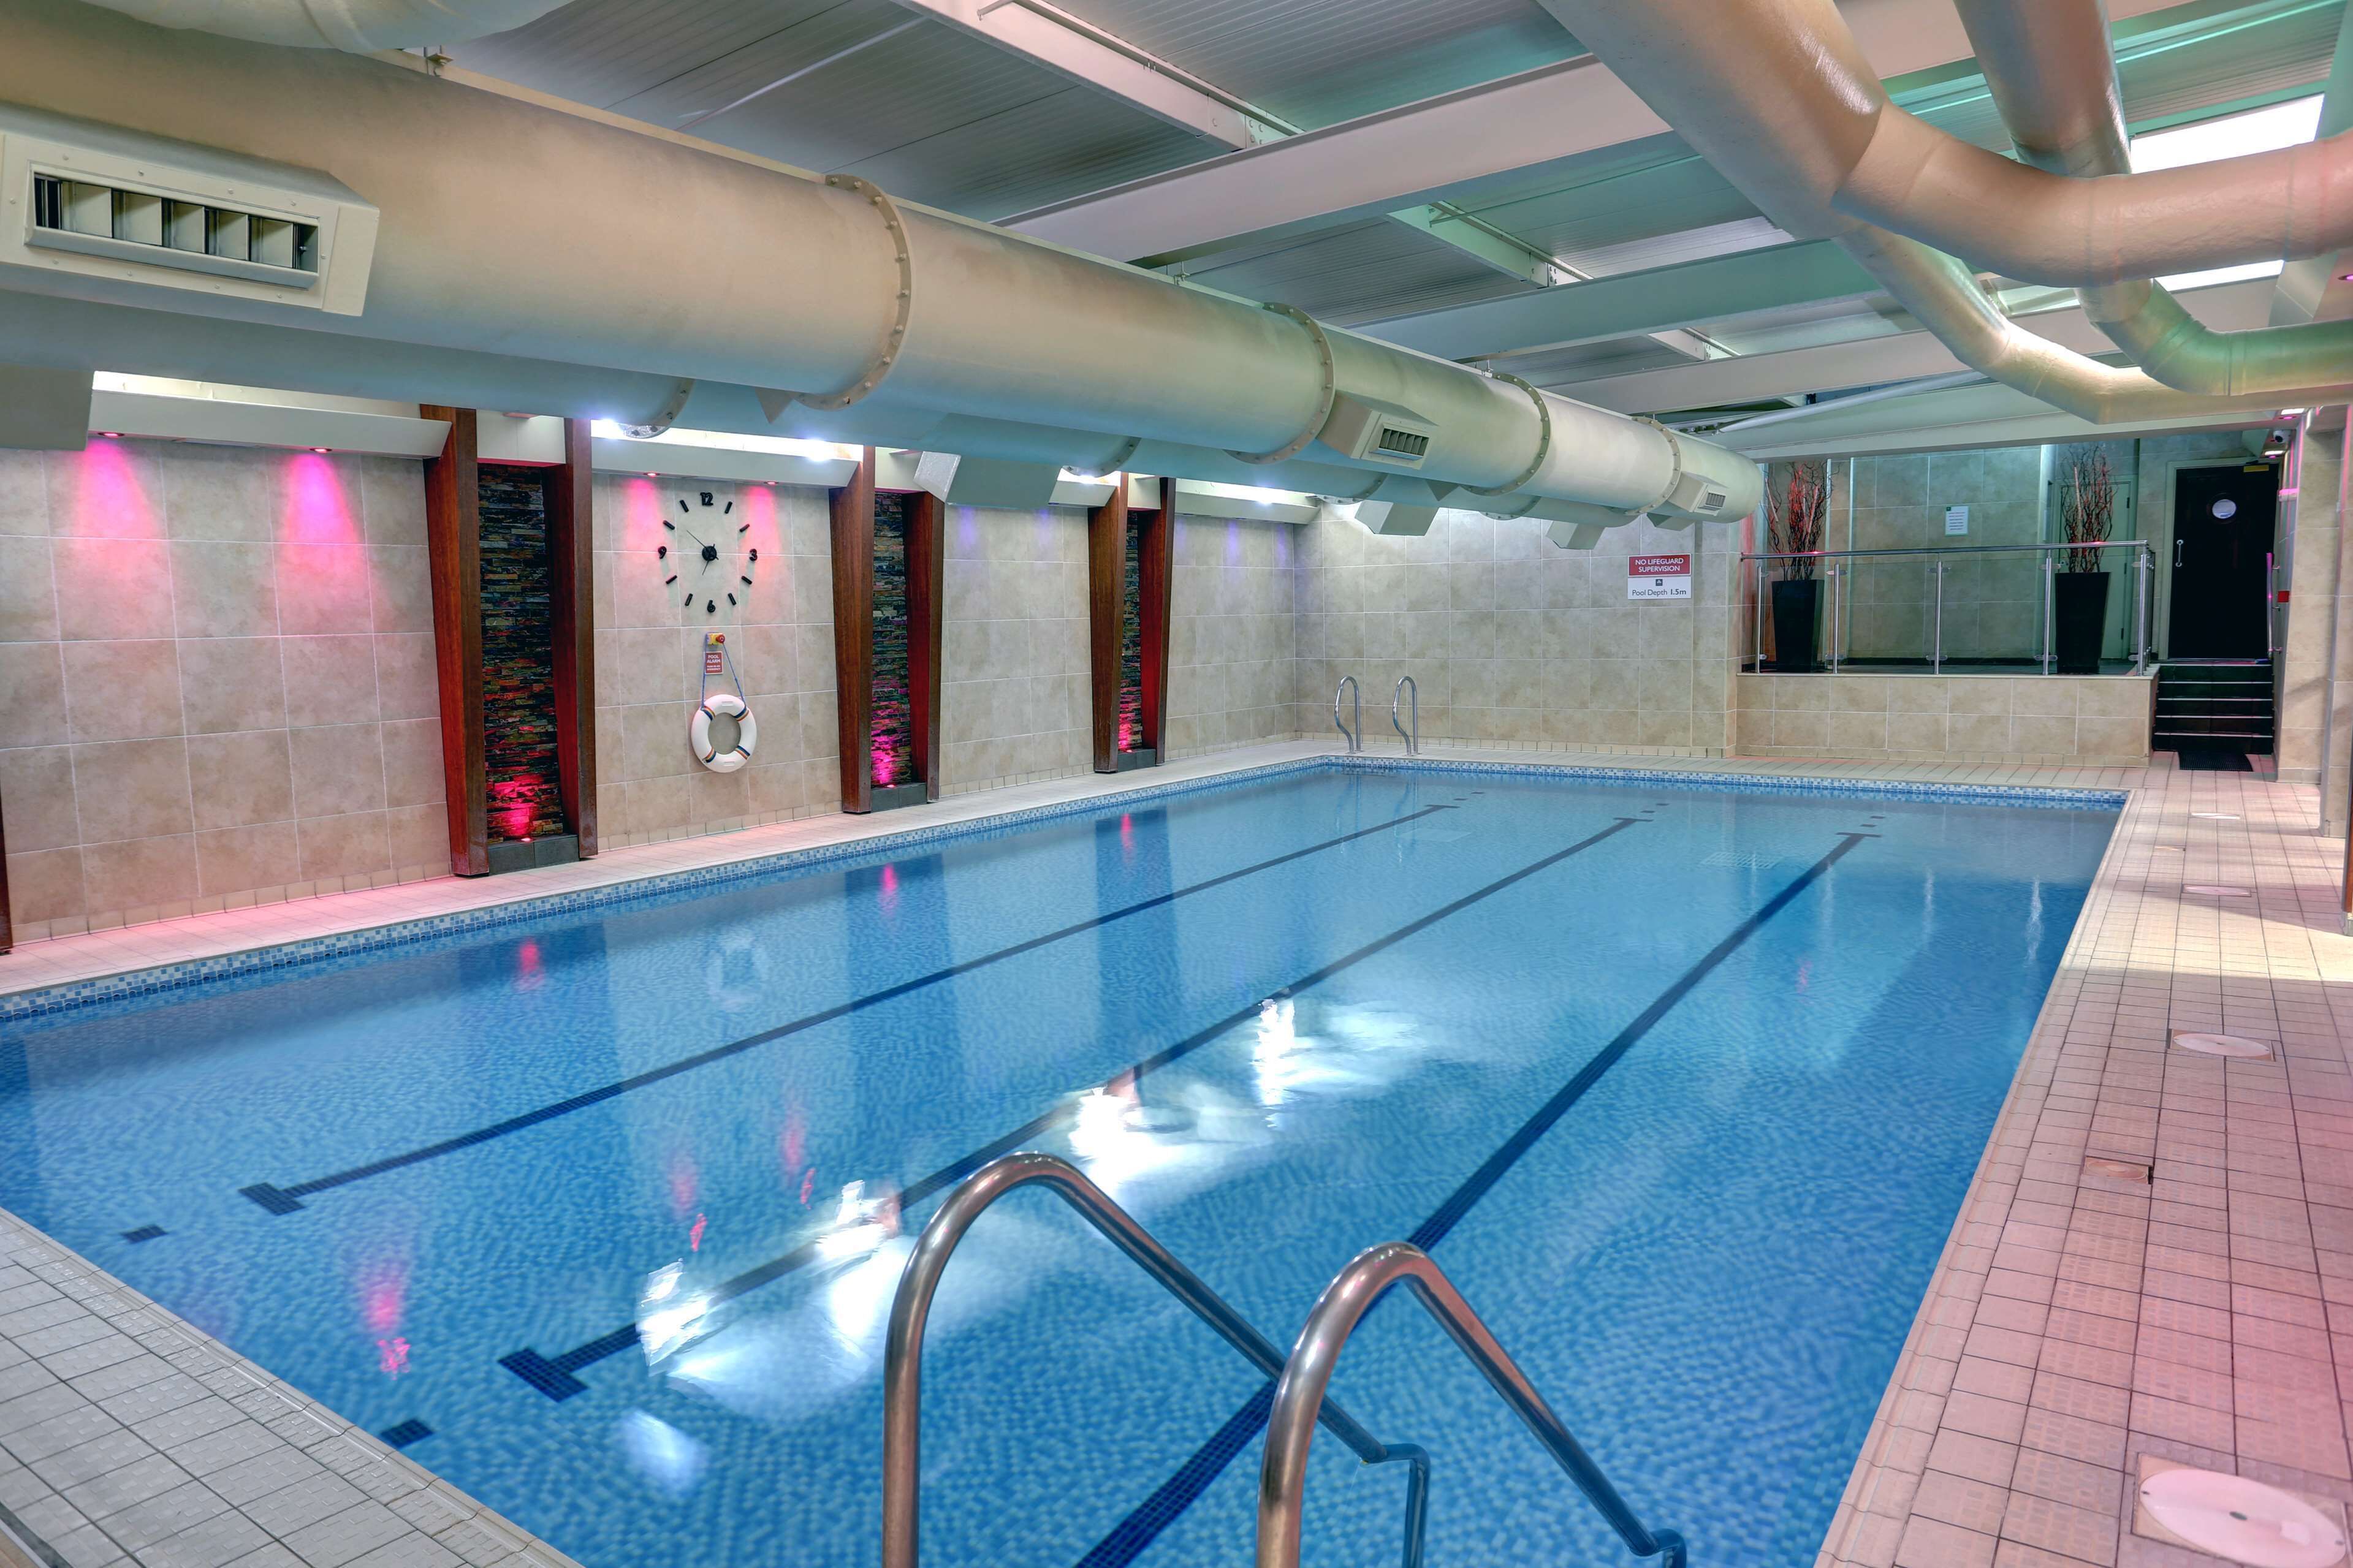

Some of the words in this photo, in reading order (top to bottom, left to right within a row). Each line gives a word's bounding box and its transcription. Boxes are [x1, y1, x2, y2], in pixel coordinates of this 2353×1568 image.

[699, 492, 714, 506] 12
[658, 545, 667, 559] 9
[749, 548, 758, 561] 3
[1648, 589, 1668, 597] Depth
[707, 599, 716, 613] 6
